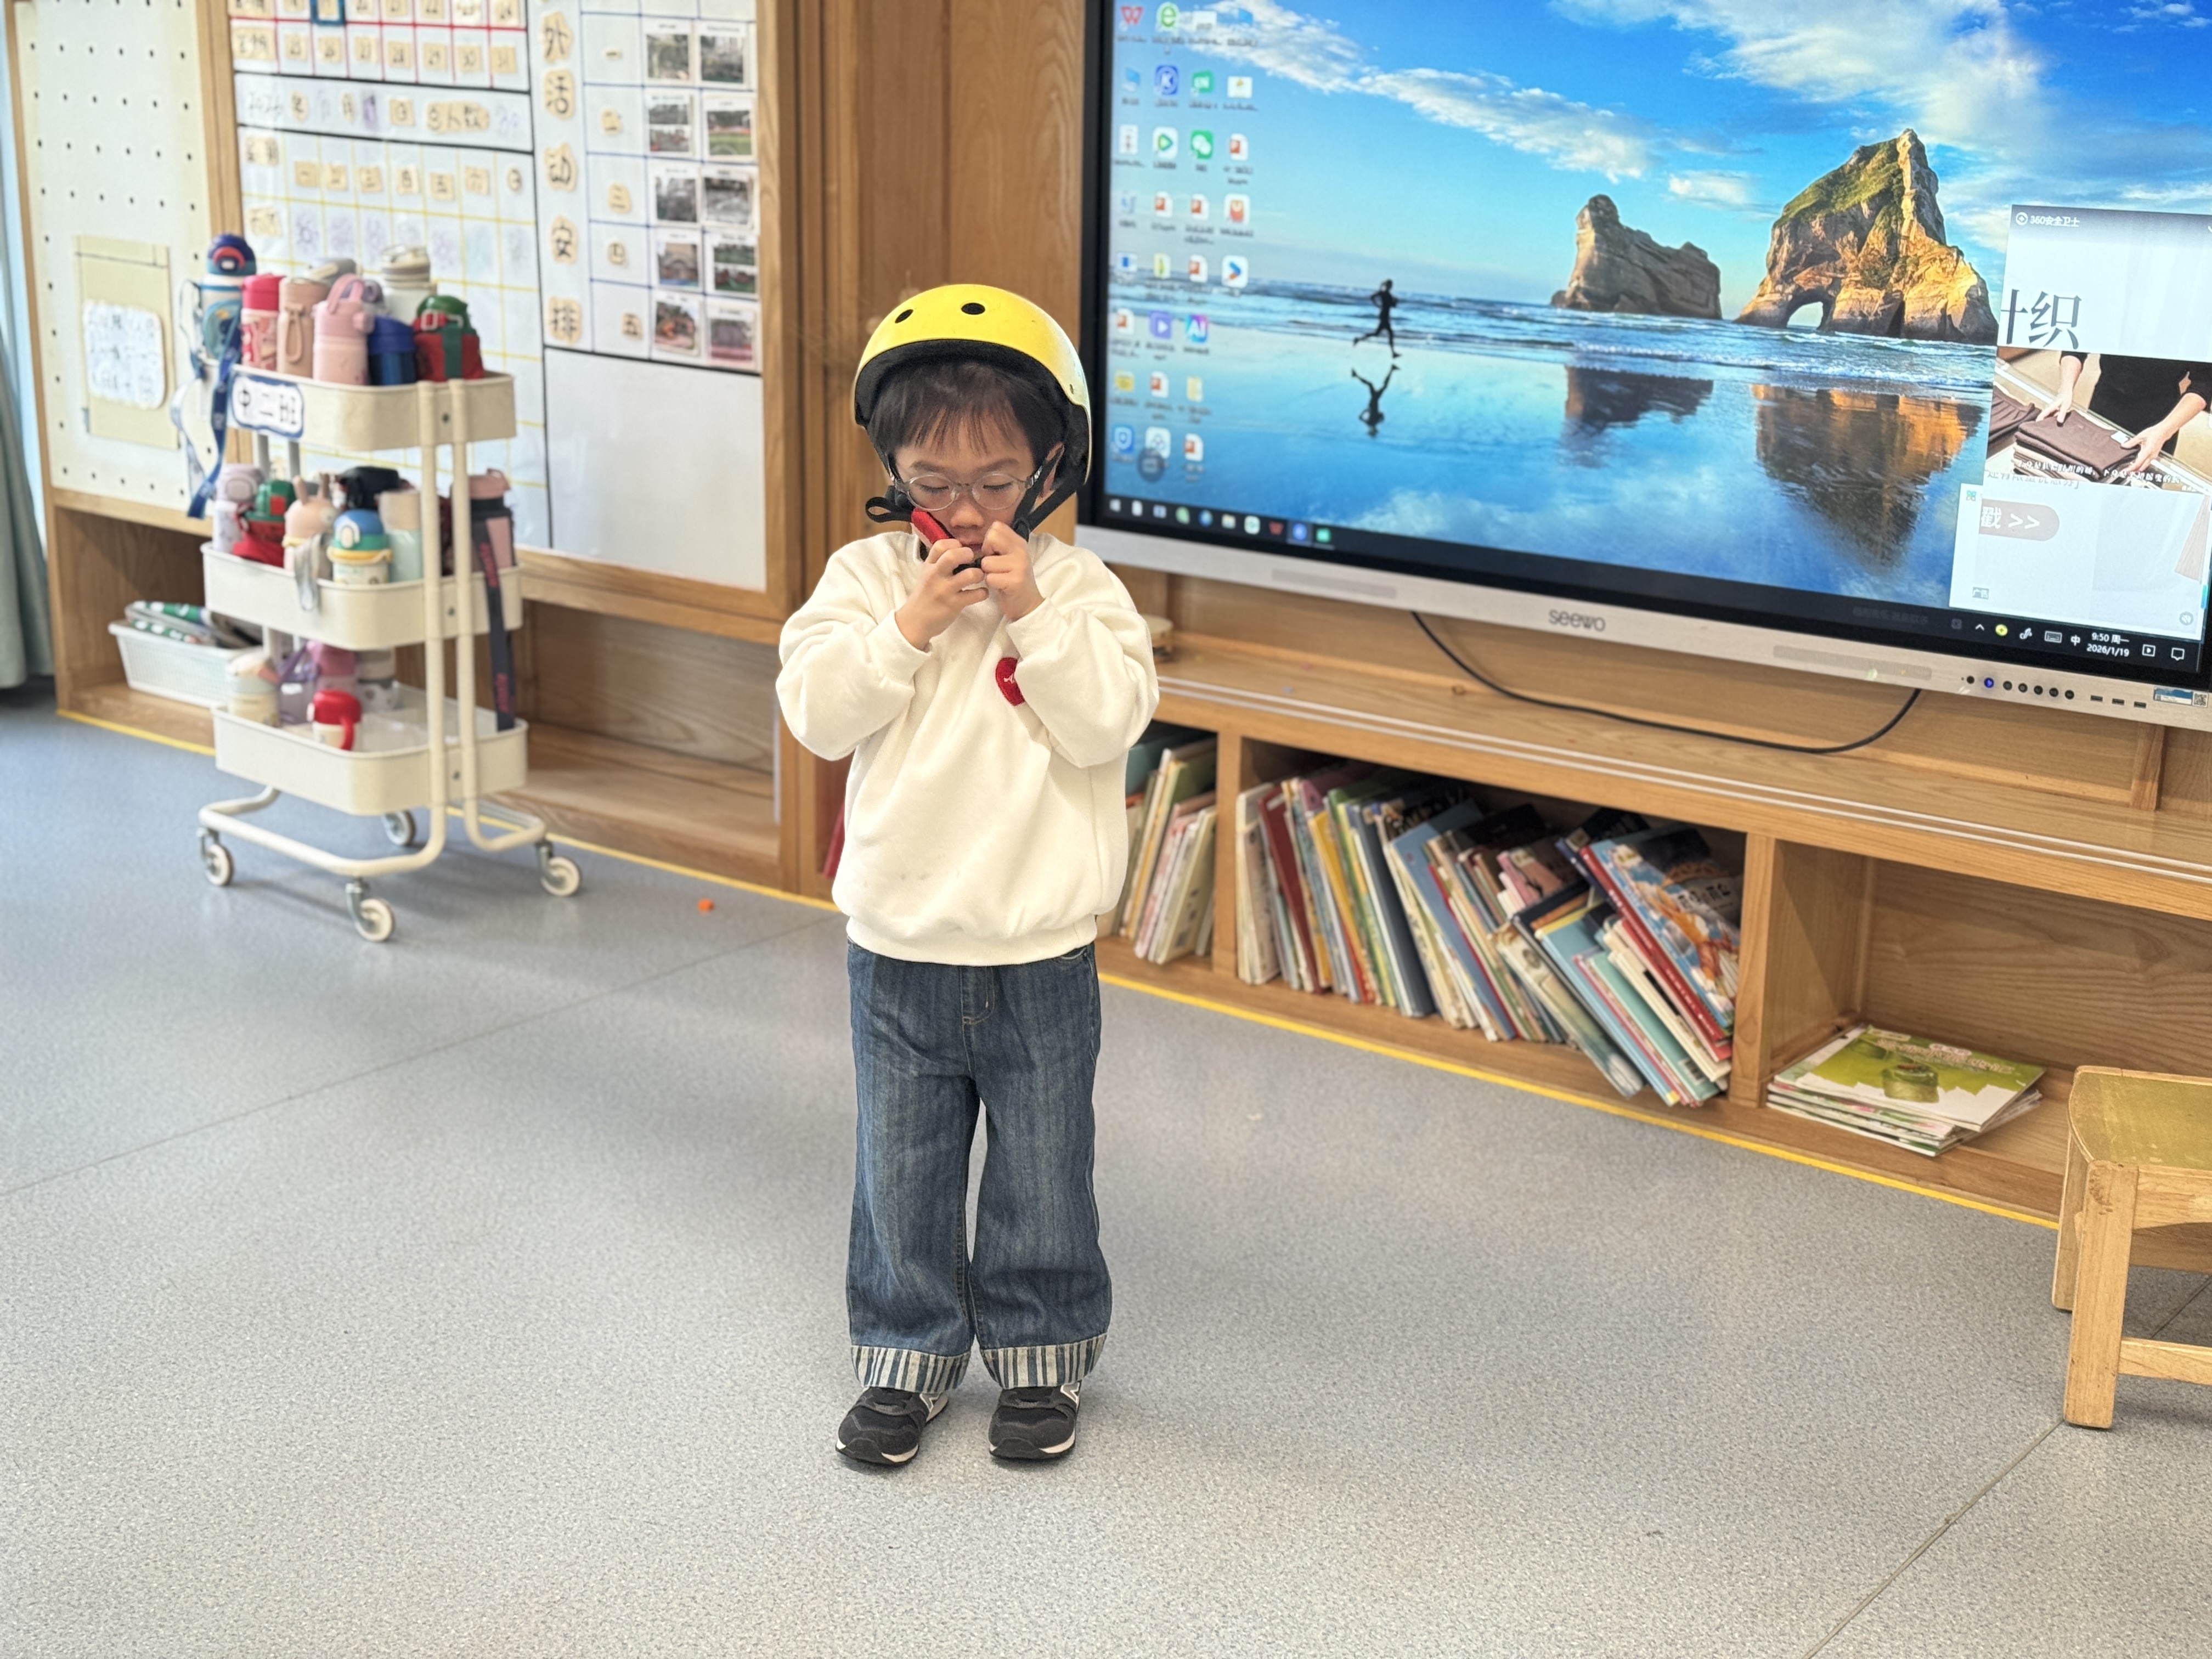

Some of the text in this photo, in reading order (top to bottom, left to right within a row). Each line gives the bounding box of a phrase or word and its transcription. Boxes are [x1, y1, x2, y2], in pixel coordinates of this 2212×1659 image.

[2030, 215, 2080, 227] 360安全卫士
[237, 385, 297, 425] 中二班
[1548, 609, 1606, 632] seewo
[2070, 634, 2081, 647] 中
[2091, 632, 2130, 645] 9:50 周一
[2086, 643, 2130, 657] 2026/1/19
